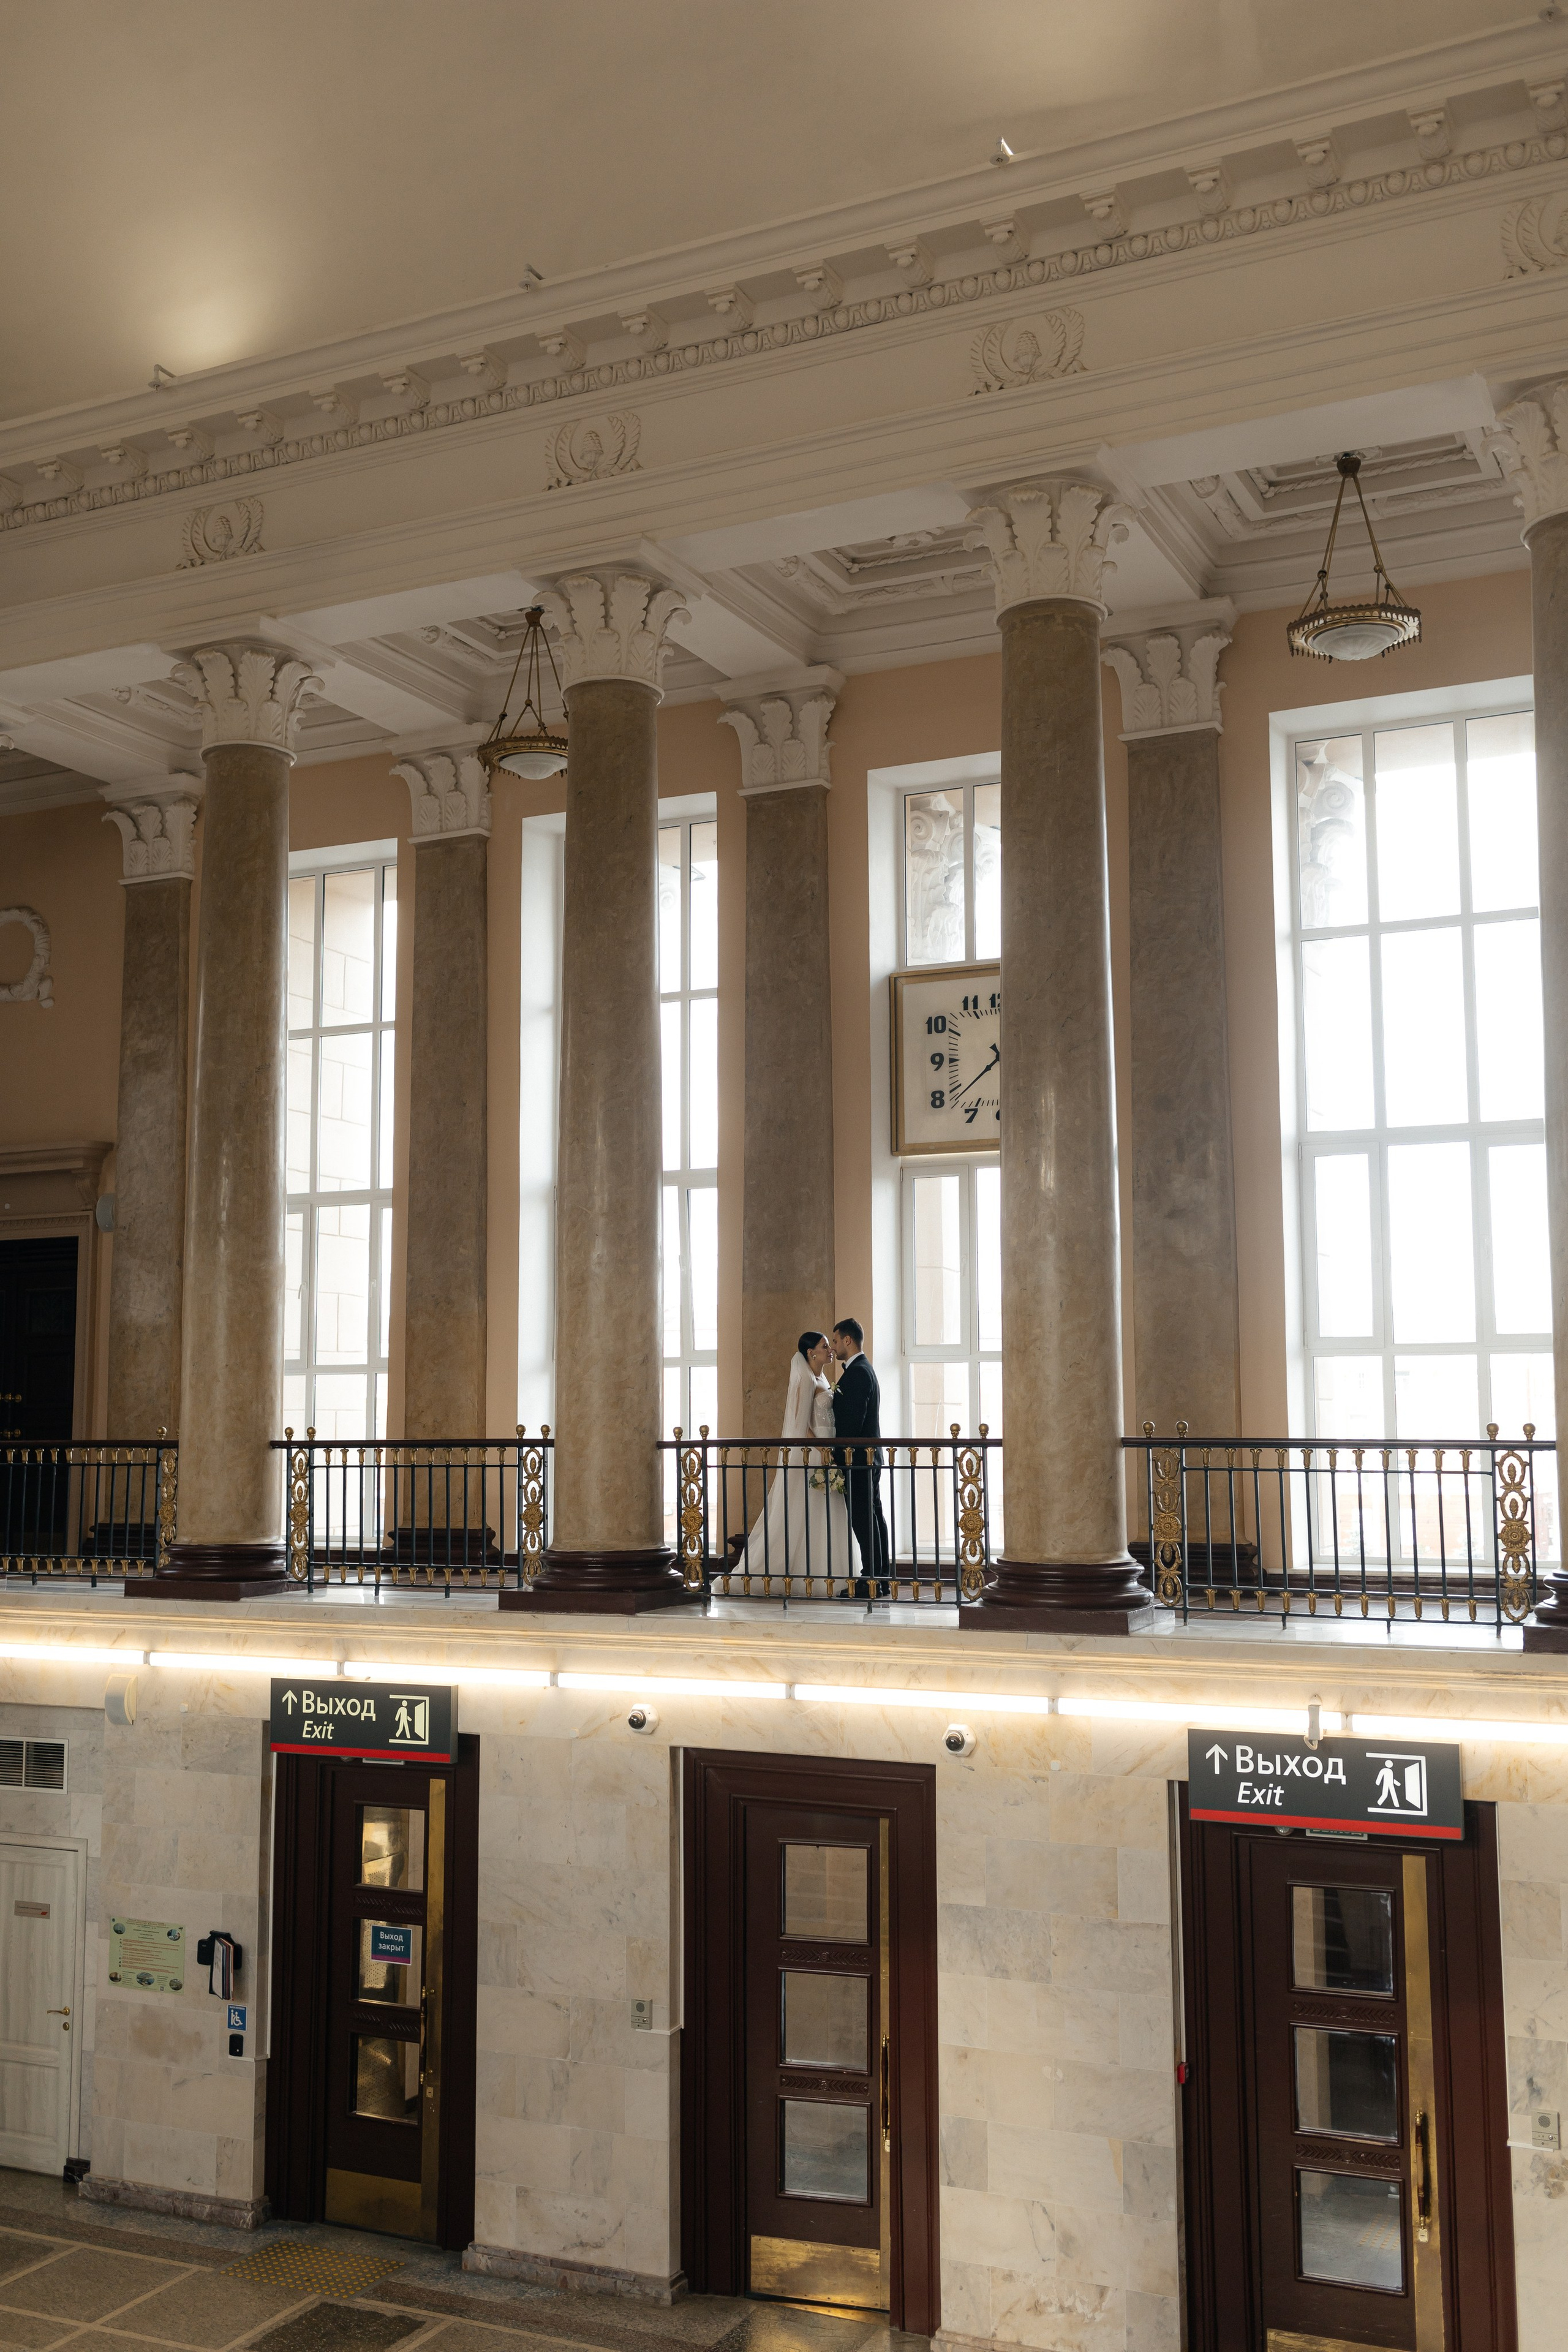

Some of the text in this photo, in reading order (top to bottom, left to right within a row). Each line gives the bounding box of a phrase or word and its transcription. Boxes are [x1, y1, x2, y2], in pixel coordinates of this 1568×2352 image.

[962, 995, 978, 1011] 11
[925, 1015, 947, 1035] 10
[930, 1052, 944, 1071] 9
[930, 1090, 945, 1109] 8
[964, 1107, 978, 1124] 7
[302, 1690, 376, 1722] Выход
[302, 1720, 334, 1740] Exit
[1235, 1744, 1346, 1785] Выход
[1237, 1782, 1284, 1806] Exit
[380, 1931, 404, 1942] Выход
[378, 1943, 405, 1952] закрыт
